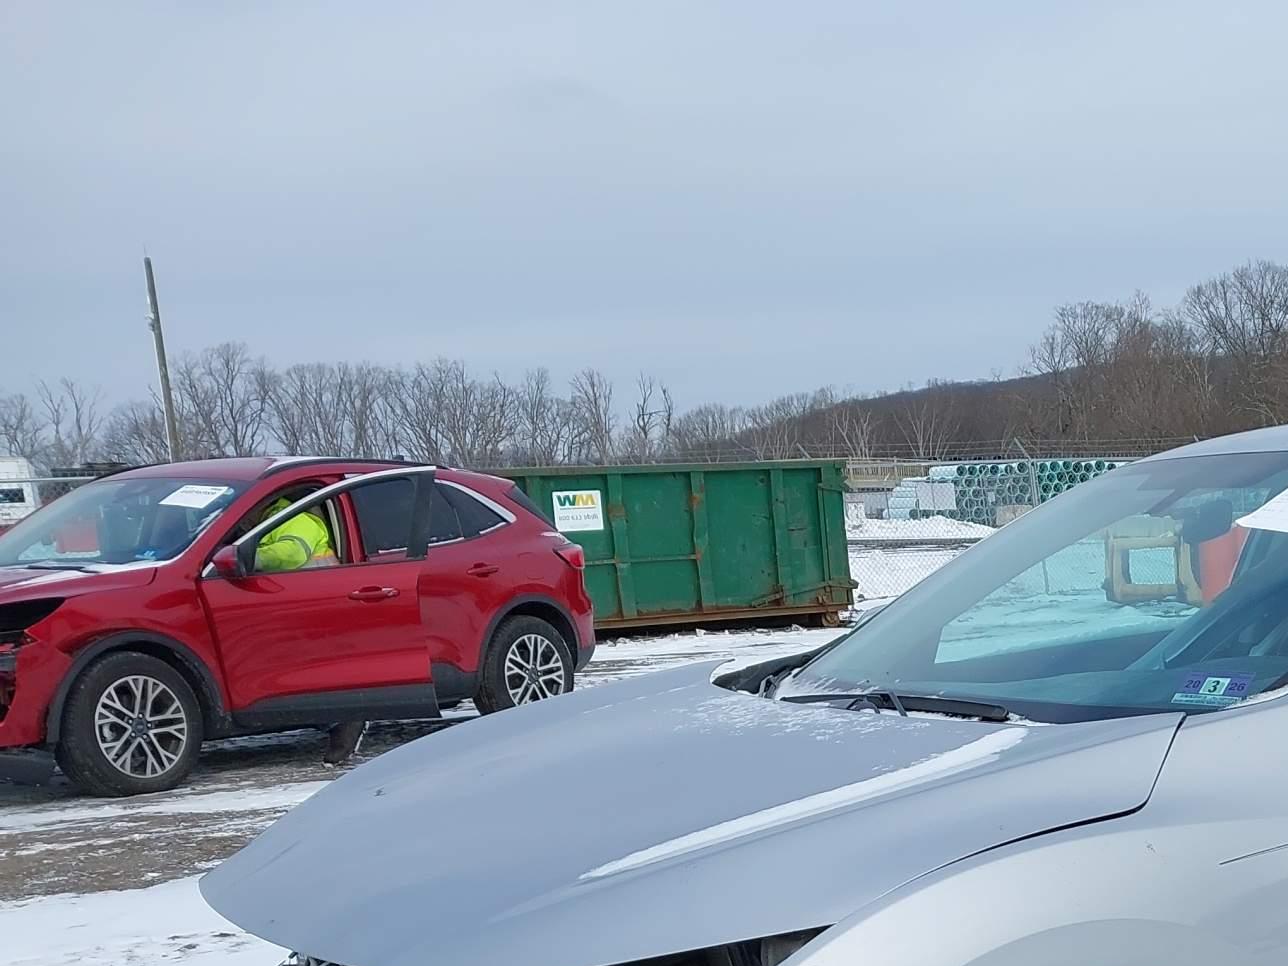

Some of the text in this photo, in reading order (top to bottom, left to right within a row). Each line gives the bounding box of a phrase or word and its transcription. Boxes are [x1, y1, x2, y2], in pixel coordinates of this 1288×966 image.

[556, 495, 596, 507] WM
[1185, 679, 1246, 693] 20 3 26
